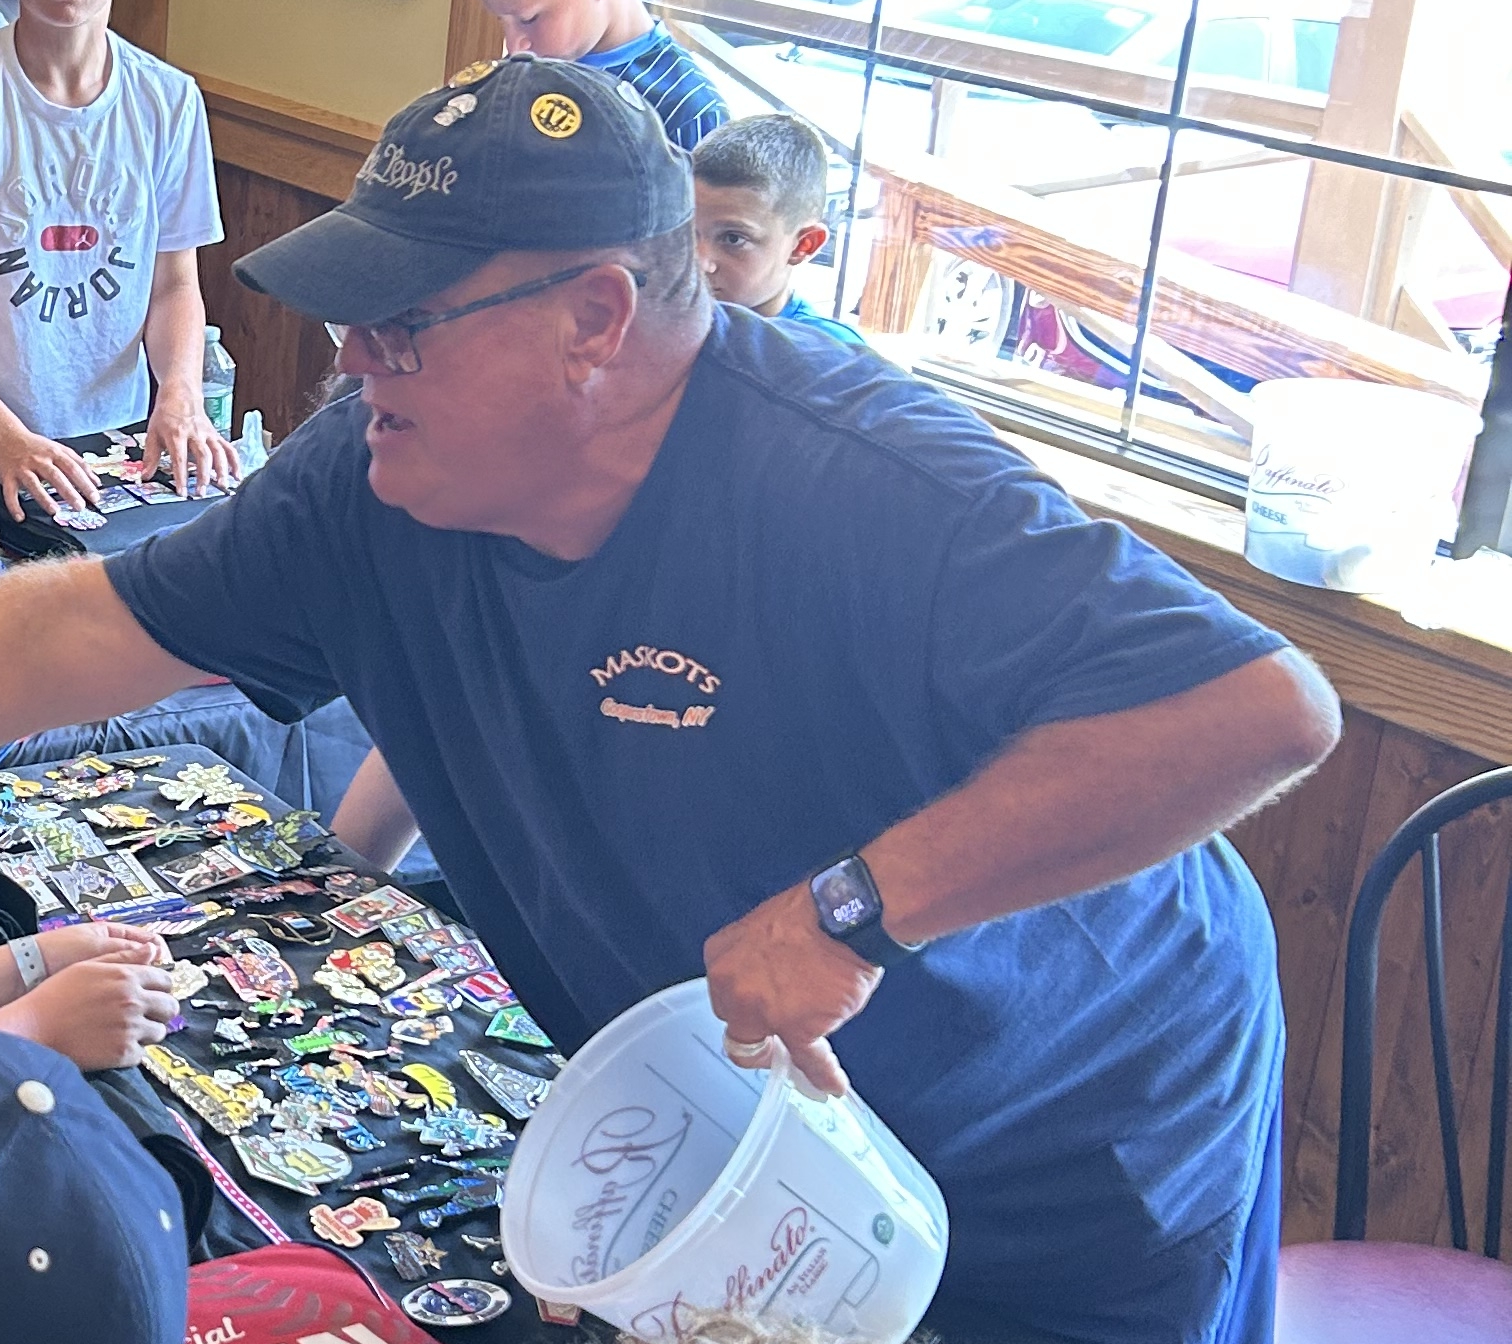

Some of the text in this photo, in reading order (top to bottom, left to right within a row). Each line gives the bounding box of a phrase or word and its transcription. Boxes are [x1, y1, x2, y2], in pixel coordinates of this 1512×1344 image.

[383, 143, 458, 201] People
[589, 644, 722, 695] MASKOTS
[681, 705, 717, 728] NY
